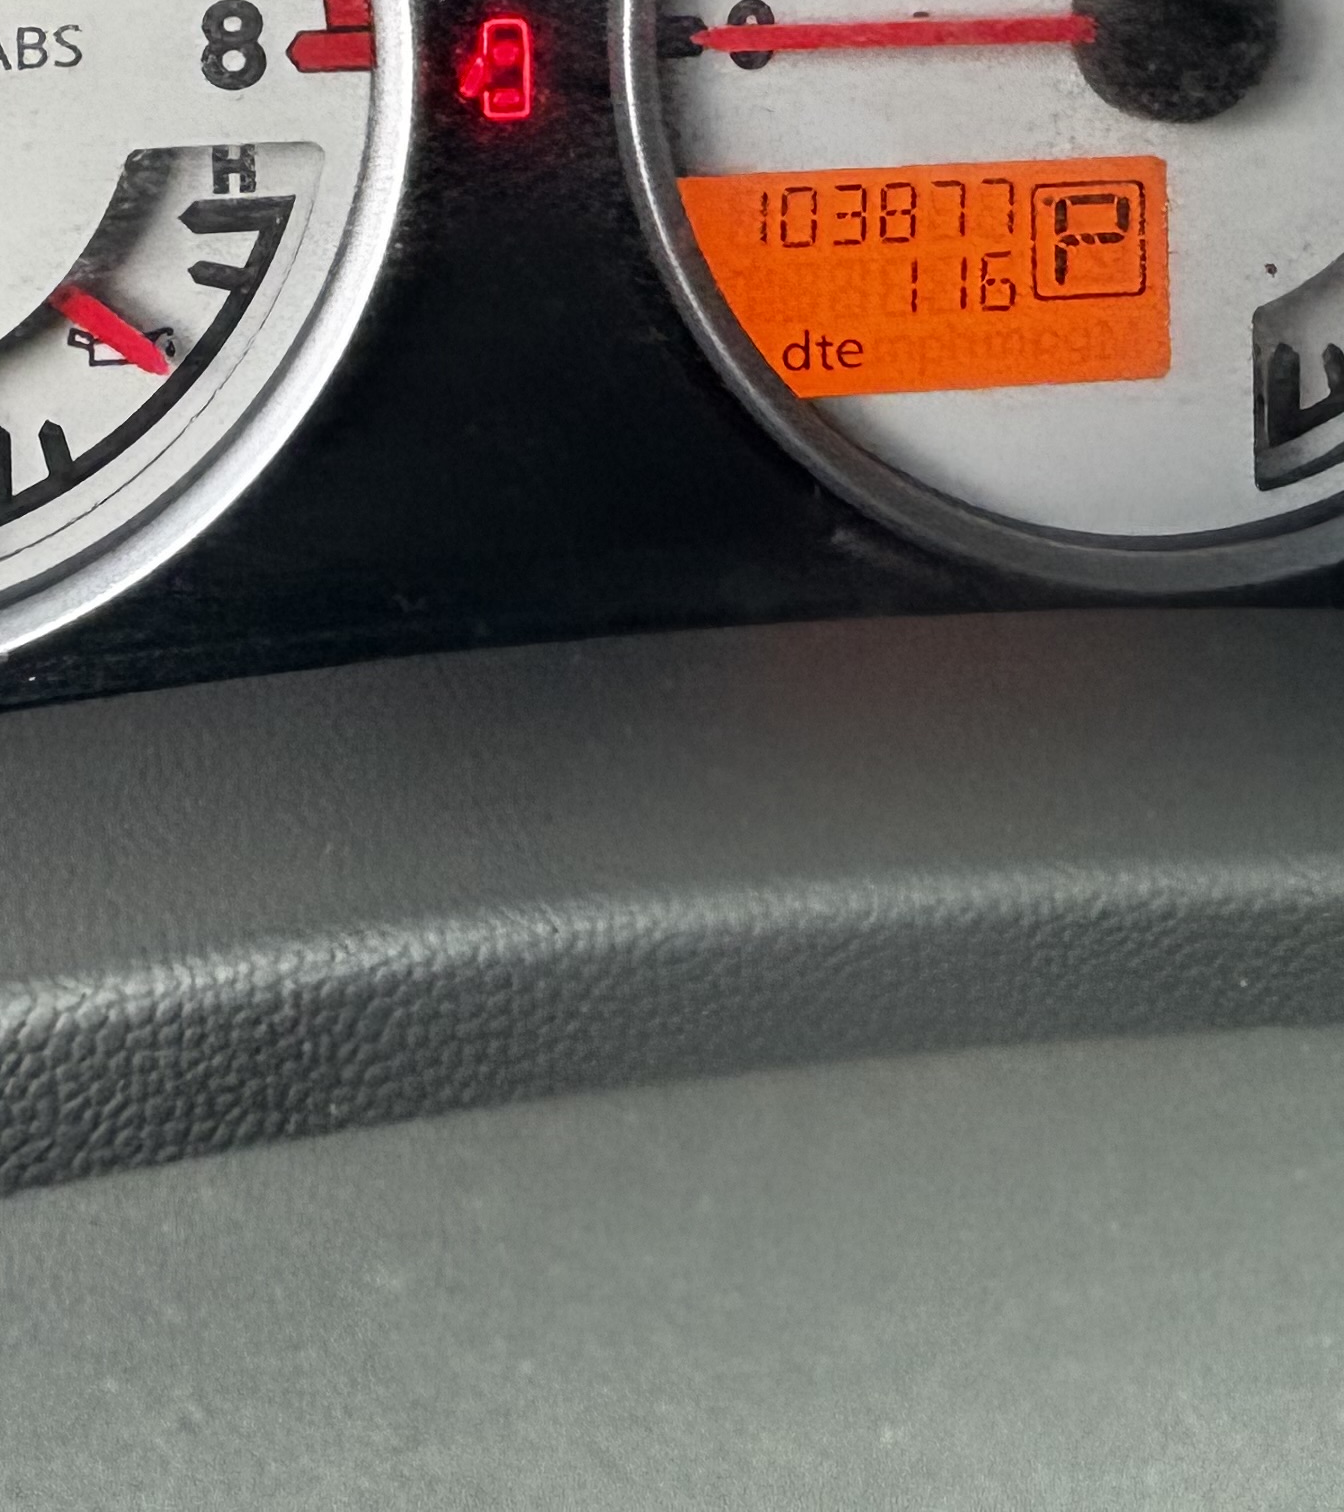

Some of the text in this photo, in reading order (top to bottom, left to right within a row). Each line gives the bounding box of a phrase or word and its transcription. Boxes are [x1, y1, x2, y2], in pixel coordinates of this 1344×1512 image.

[212, 144, 256, 194] H
[759, 178, 1016, 249] 103877
[1054, 192, 1130, 287] P
[910, 250, 1017, 312] 116
[782, 329, 864, 372] dte
